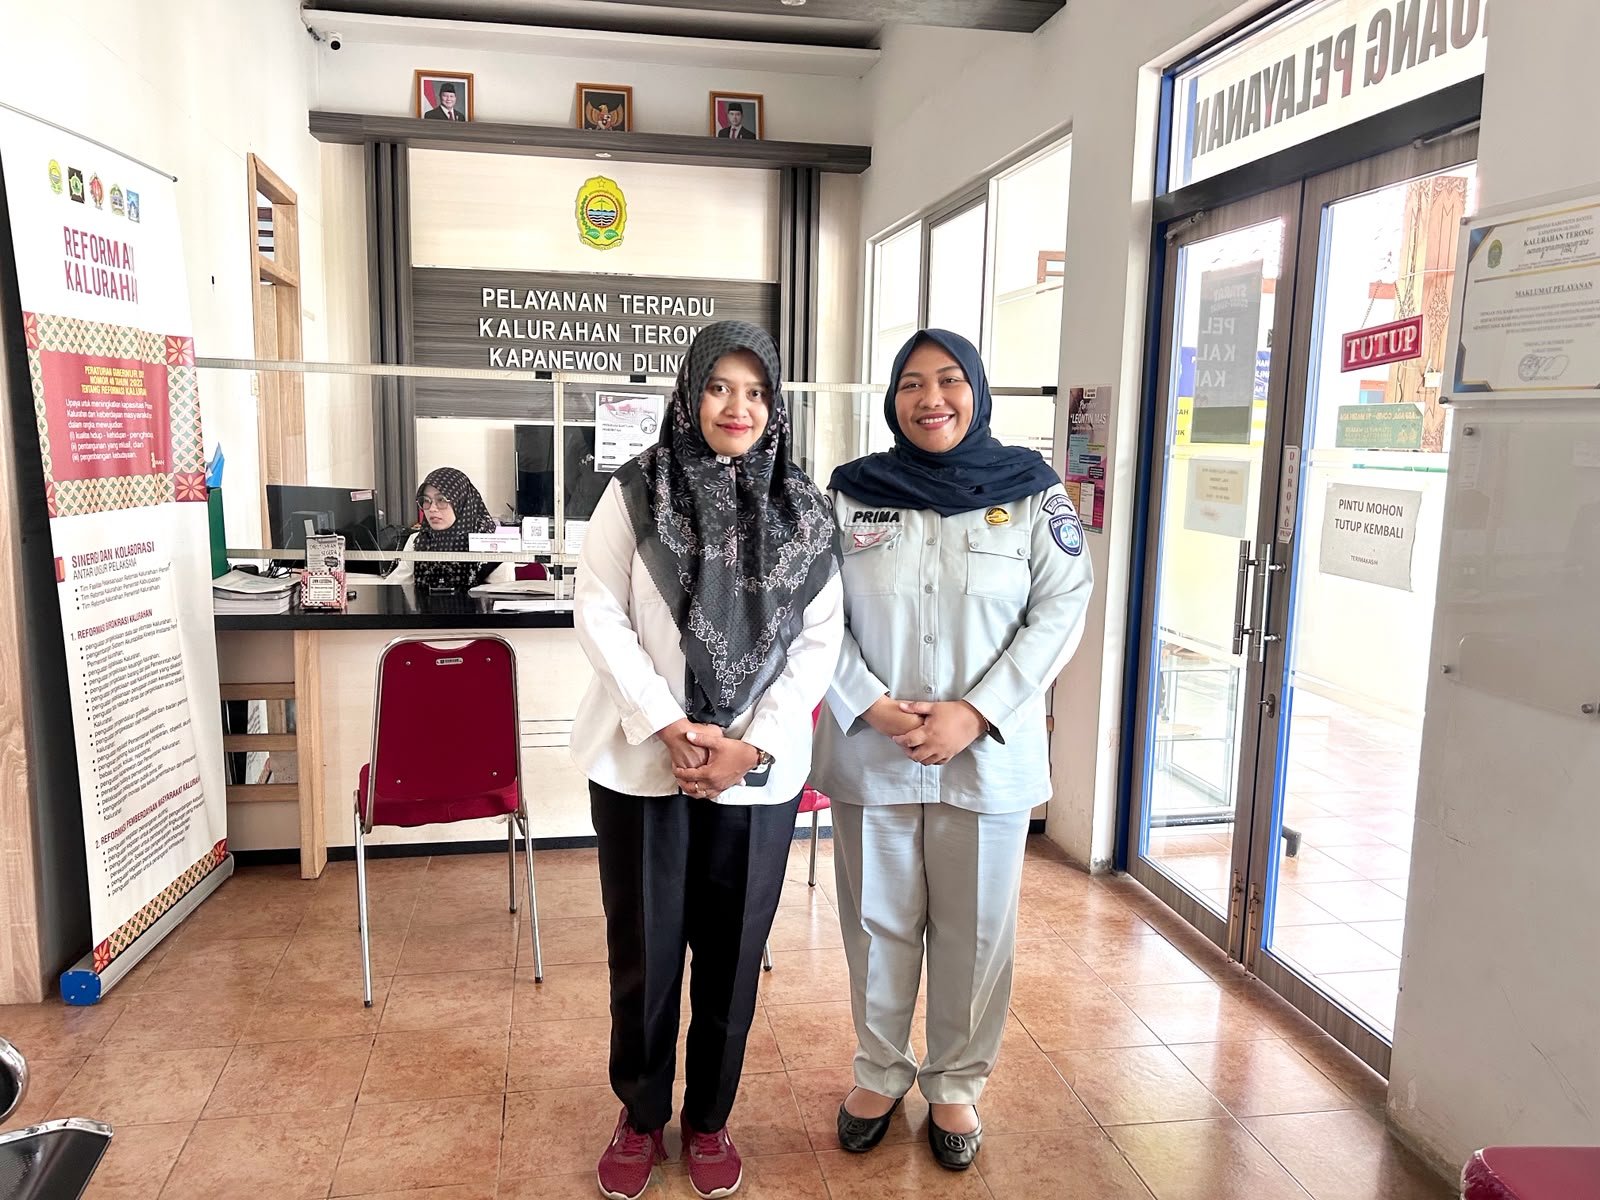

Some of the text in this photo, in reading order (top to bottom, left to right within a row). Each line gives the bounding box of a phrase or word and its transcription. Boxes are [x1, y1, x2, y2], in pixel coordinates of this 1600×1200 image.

[1523, 227, 1594, 247] KALURAHAN TERONG
[1514, 281, 1593, 297] MAKLUMAT PELAYANAN
[481, 287, 715, 317] PELAYANAN TERPADU
[478, 318, 702, 345] KALURAHAN TERON
[1346, 324, 1417, 365] TUTUP
[489, 347, 686, 373] KAPANEWON DLIN
[1284, 452, 1294, 527] DORONG
[852, 510, 900, 523] PRIMA
[1338, 499, 1403, 517] PINTU MOHON
[1335, 518, 1404, 539] TUTUP KEMBALI
[115, 541, 155, 559] KOLABORASI
[73, 567, 94, 580] ANTAR
